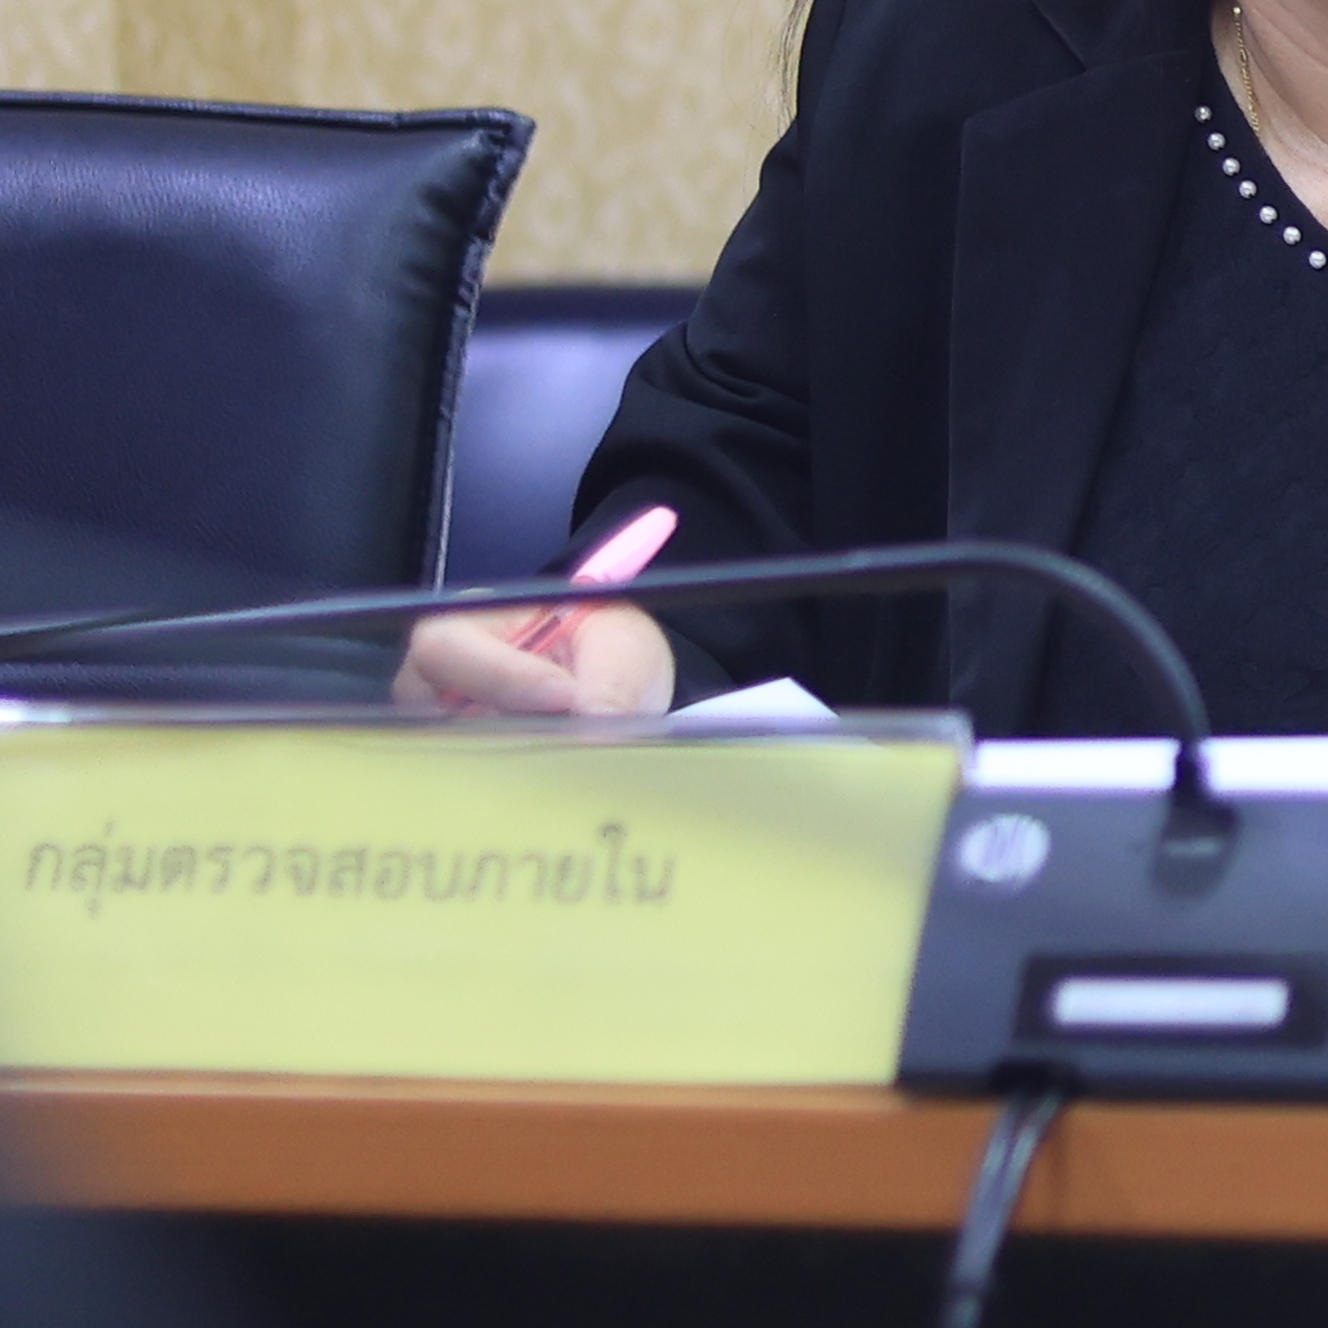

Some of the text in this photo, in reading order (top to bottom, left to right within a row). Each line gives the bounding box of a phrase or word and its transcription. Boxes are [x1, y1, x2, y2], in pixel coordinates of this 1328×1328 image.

[24, 818, 677, 920] กลุ่มตรวจสอบภายใน
